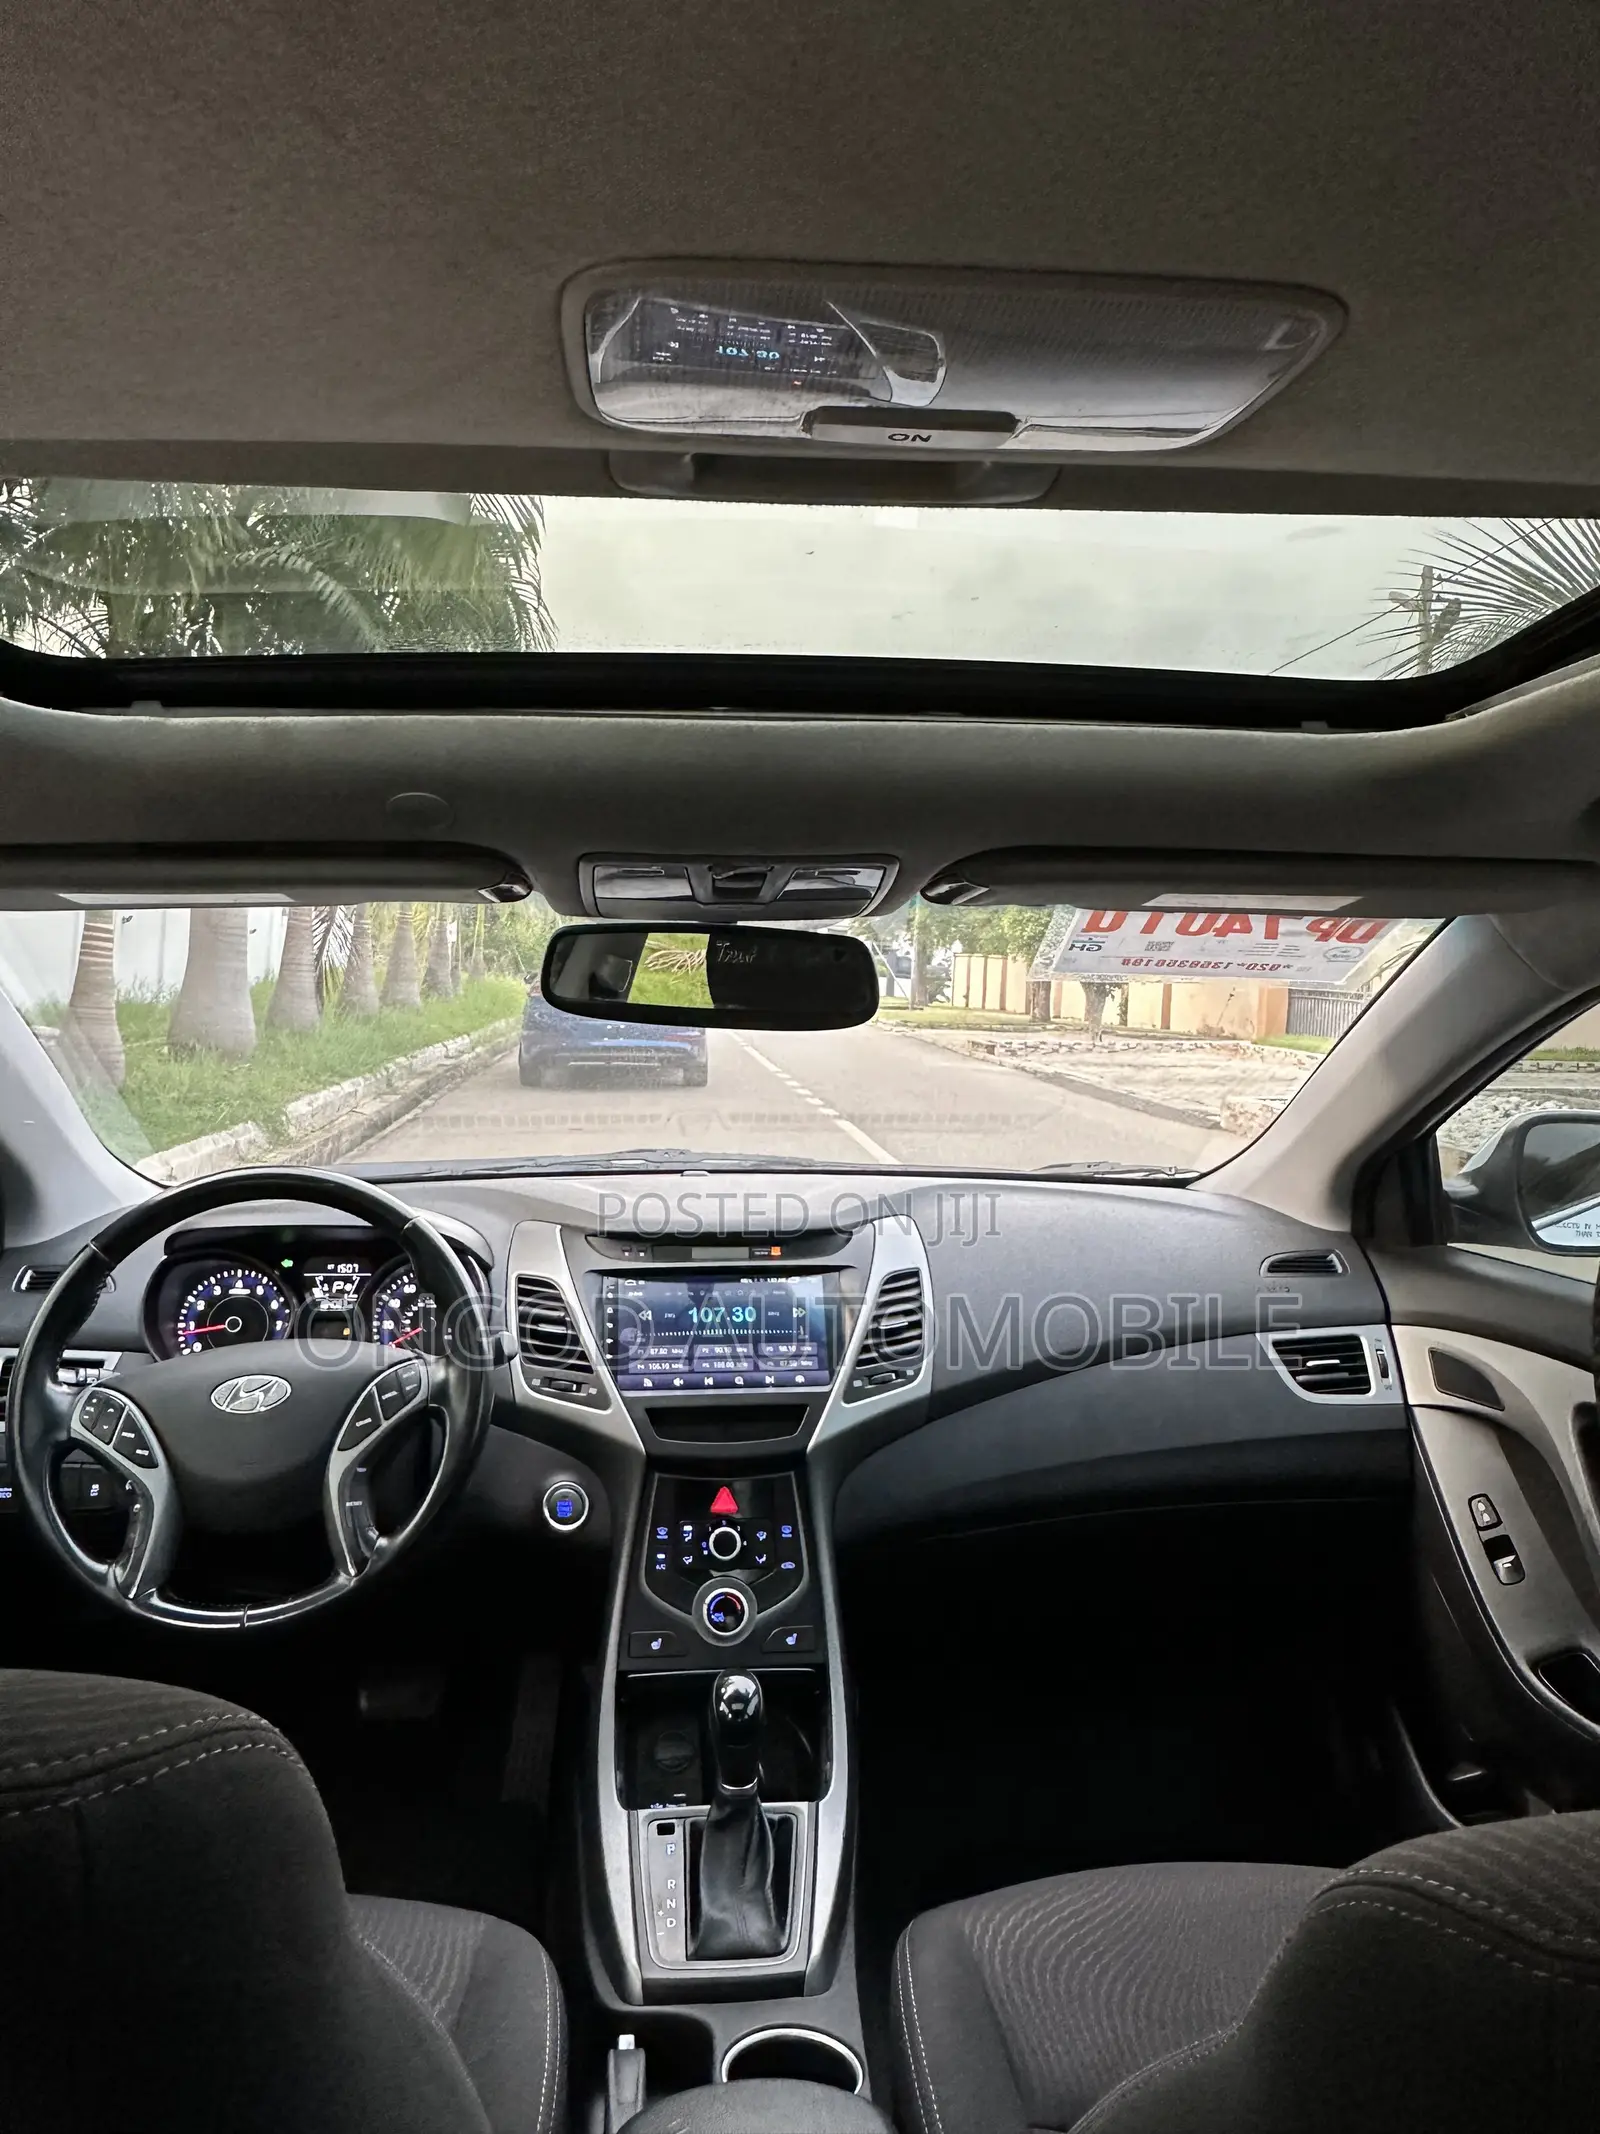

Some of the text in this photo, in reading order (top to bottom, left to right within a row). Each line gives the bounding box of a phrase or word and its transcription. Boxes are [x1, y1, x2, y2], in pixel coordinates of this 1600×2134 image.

[888, 433, 932, 442] ON
[688, 1306, 757, 1323] 107.30
[667, 1844, 675, 1854] P
[667, 1879, 676, 1889] R
[667, 1899, 676, 1908] N
[666, 1918, 676, 1928] D
